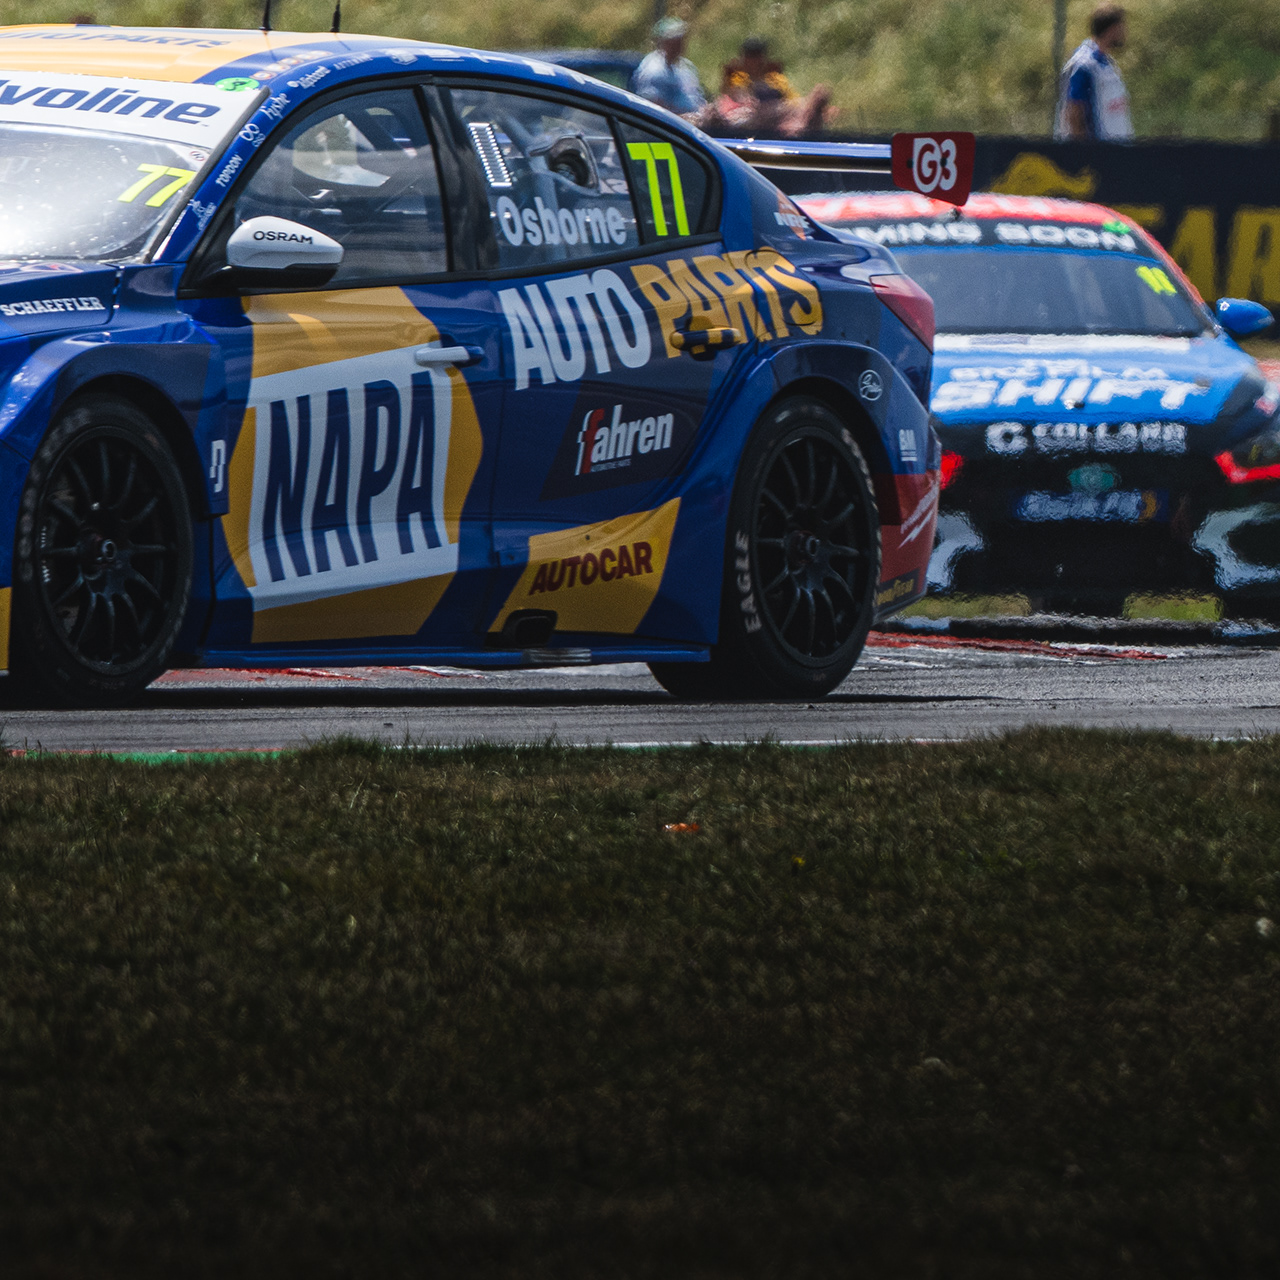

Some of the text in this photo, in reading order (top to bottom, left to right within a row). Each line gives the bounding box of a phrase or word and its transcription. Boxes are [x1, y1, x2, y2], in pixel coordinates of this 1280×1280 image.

[116, 163, 196, 208] 77
[215, 152, 243, 188] TOPDON
[626, 141, 691, 237] 77
[912, 137, 959, 194] G3
[253, 230, 314, 246] OSRAM
[495, 196, 628, 247] Osborne
[838, 221, 982, 245] MING
[497, 246, 823, 392] AUTO PARTS
[930, 378, 1211, 413] SHIFT
[575, 404, 674, 476] fahren
[261, 370, 443, 584] NAPA
[528, 540, 654, 596] AUTOCAR
[734, 529, 762, 634] EAGLE
